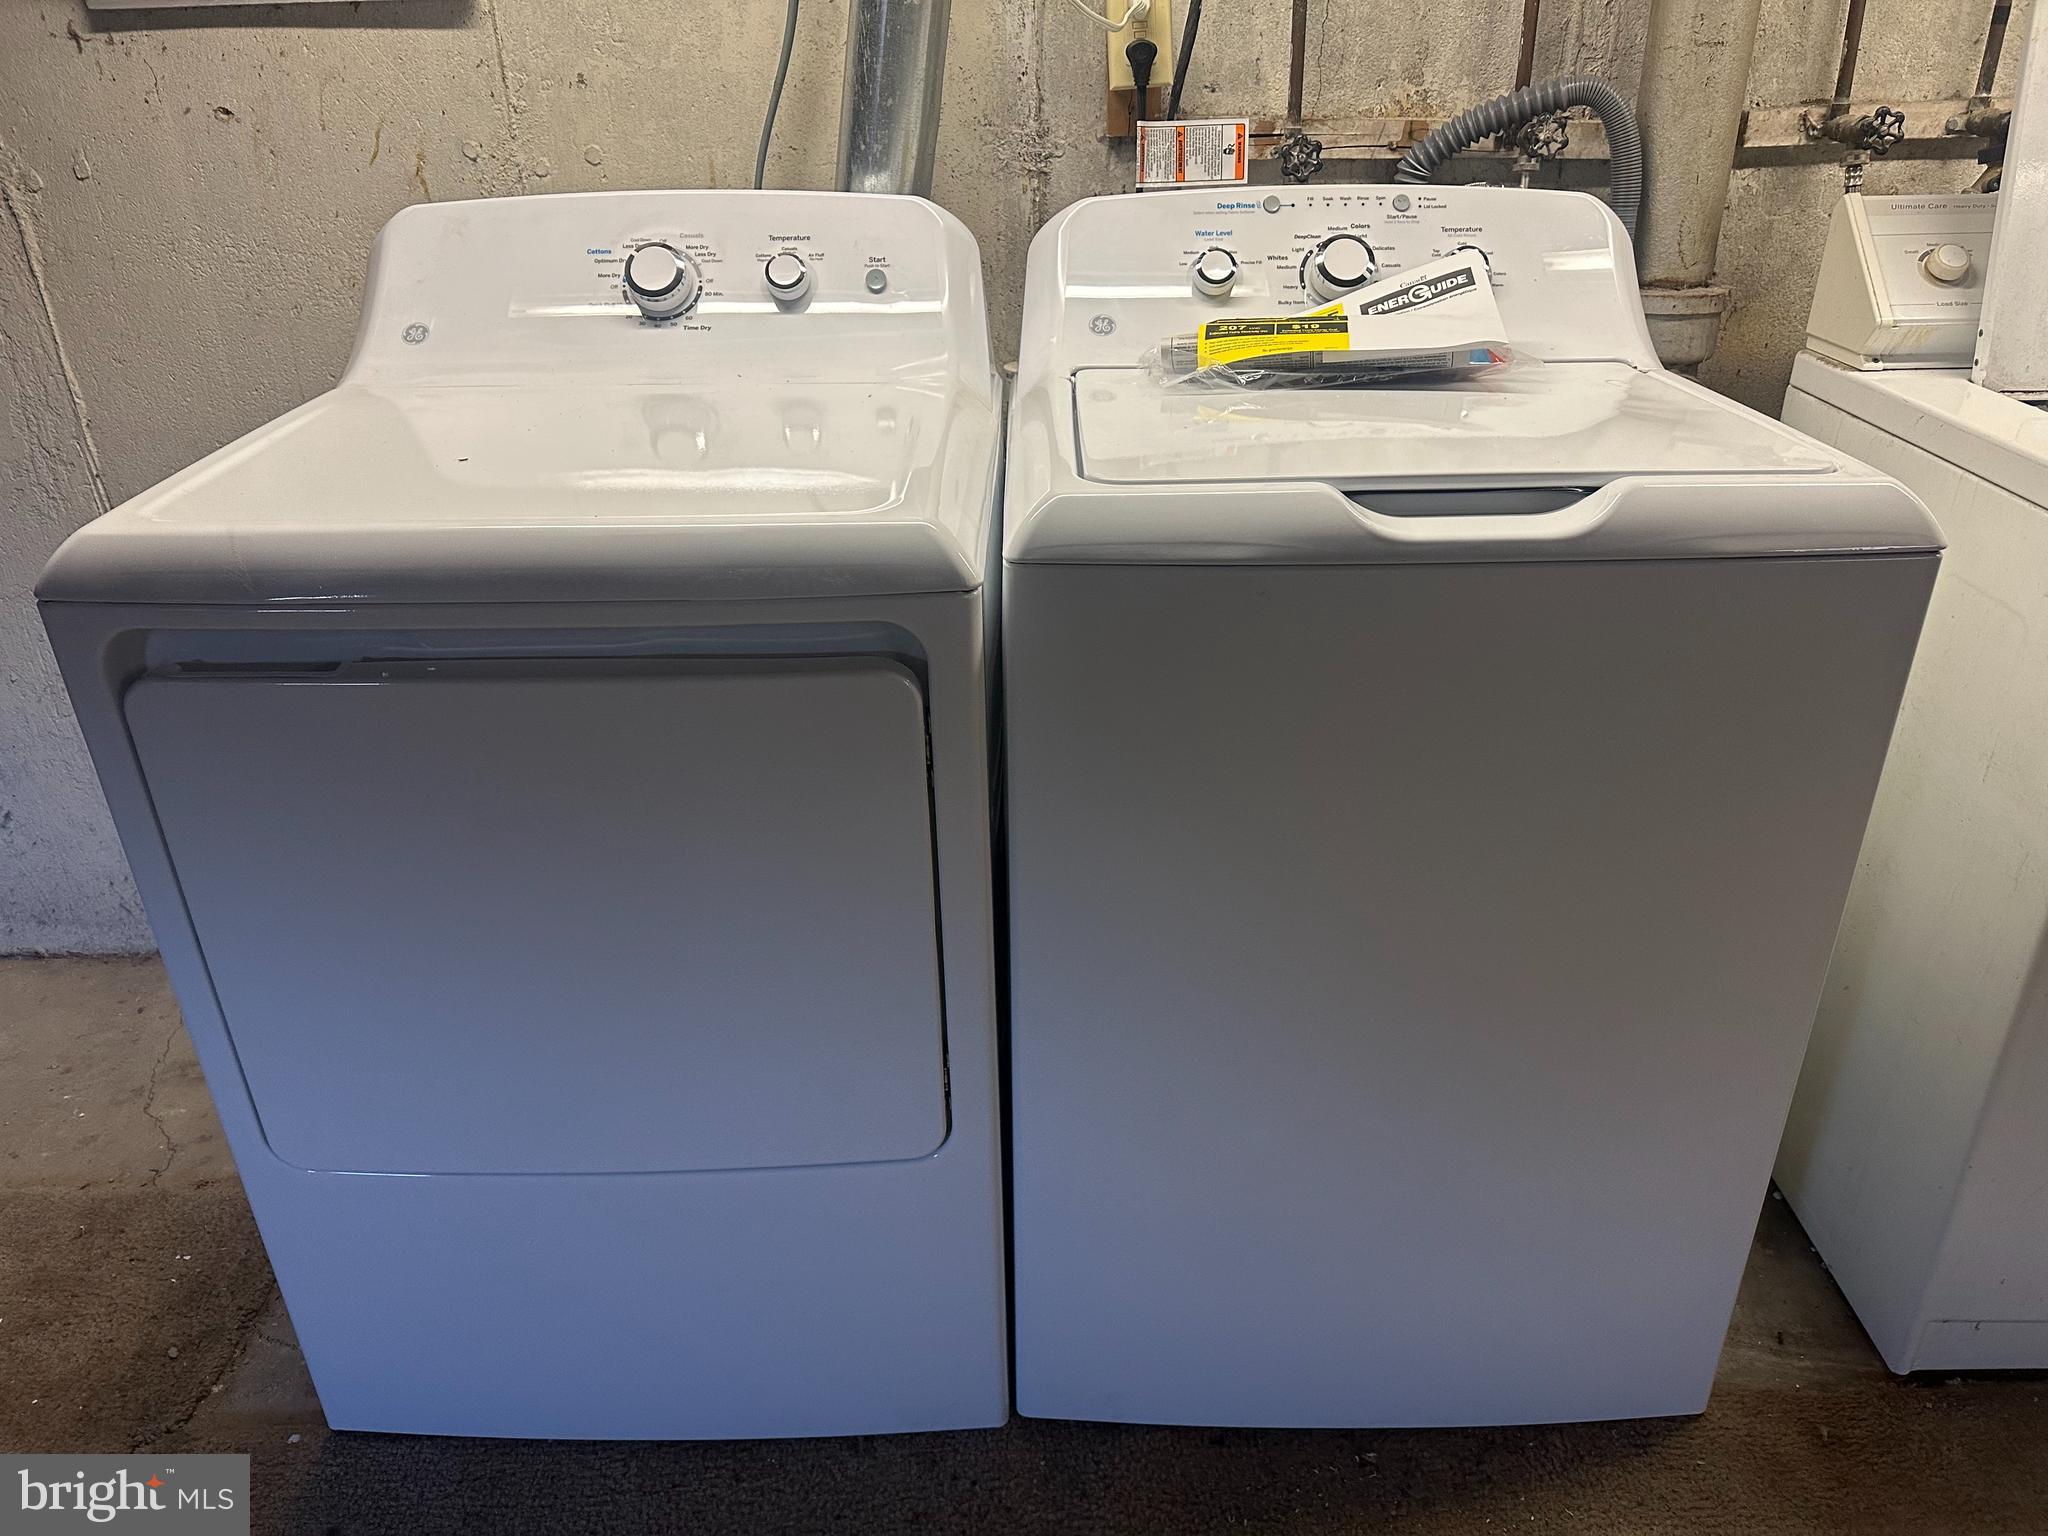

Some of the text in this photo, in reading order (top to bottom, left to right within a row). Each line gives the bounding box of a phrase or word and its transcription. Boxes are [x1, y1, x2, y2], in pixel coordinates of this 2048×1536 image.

[1217, 202, 1235, 210] Deep
[1441, 226, 1483, 234] Temperature
[768, 234, 811, 242] Temperature
